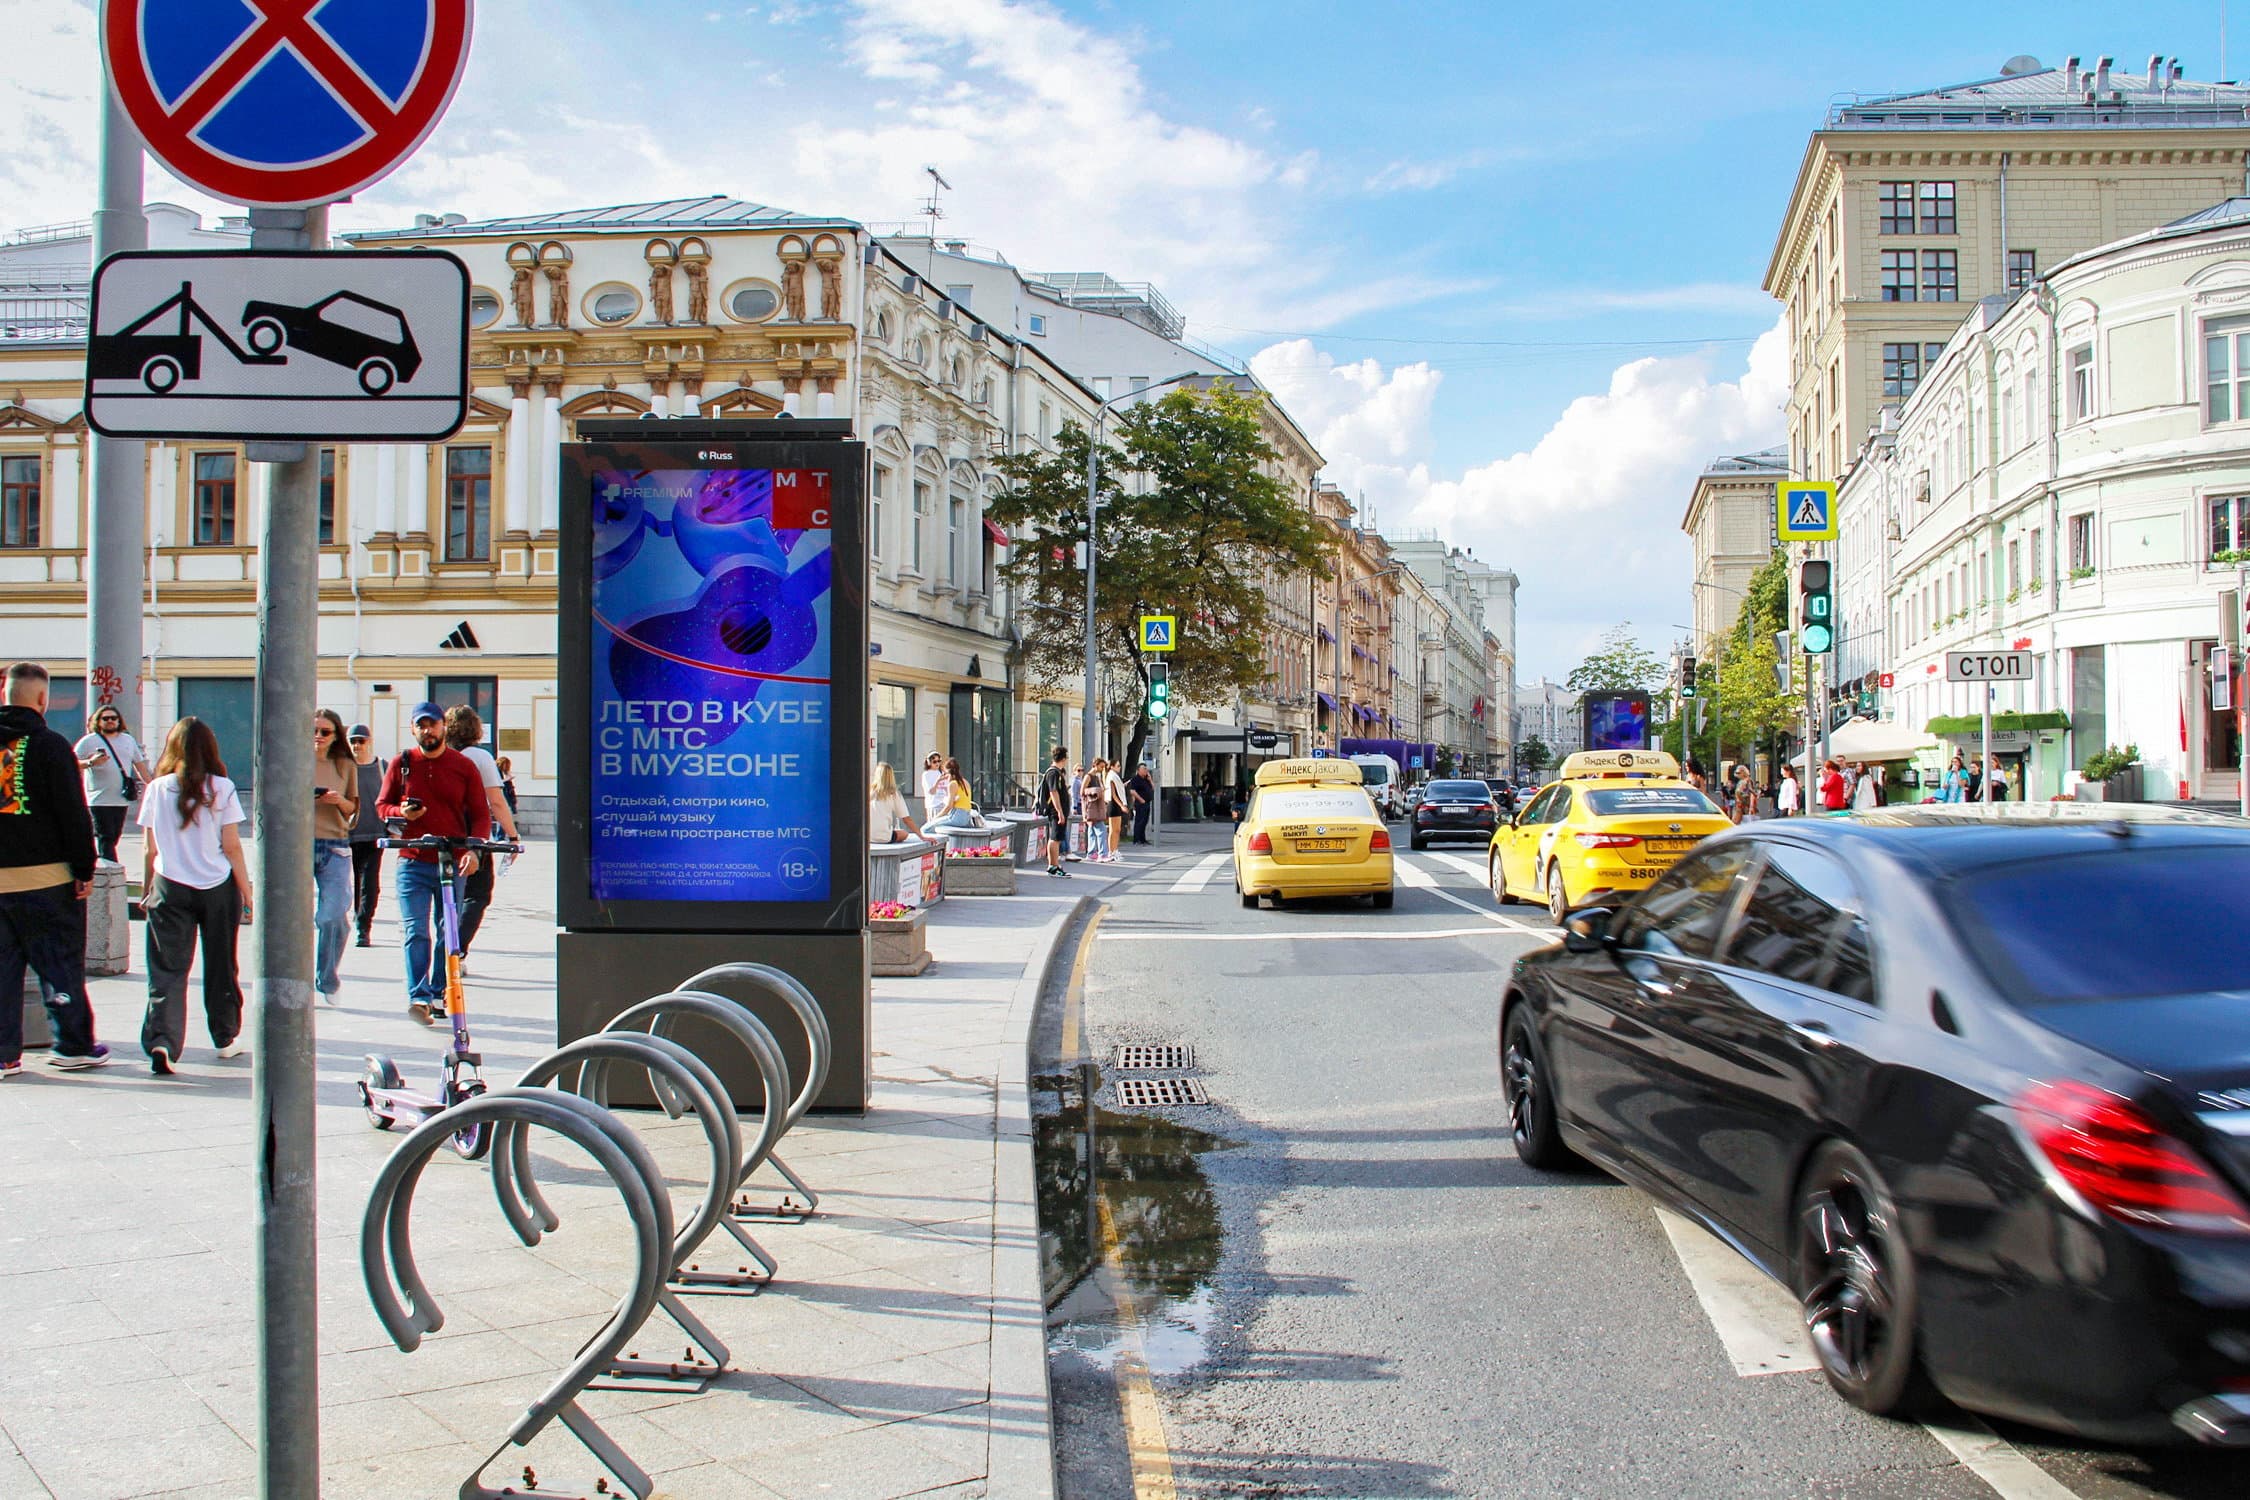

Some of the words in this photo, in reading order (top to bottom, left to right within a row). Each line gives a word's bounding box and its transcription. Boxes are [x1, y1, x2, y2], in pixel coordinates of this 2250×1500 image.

[709, 451, 733, 460] Russ
[623, 487, 693, 498] PREMIUM
[1960, 655, 2020, 676] СТОП
[600, 700, 694, 724] ЛЕТО
[702, 700, 724, 724] В
[732, 700, 823, 724] КУБЕ
[600, 727, 624, 750] С
[631, 727, 707, 750] МТС
[601, 753, 622, 776] В
[631, 753, 801, 776] МУЗЕОНЕ
[1584, 756, 1616, 766] Яндекс
[1619, 755, 1632, 766] Go
[1636, 756, 1660, 765] Такси
[1280, 763, 1312, 775] Яндекс
[601, 794, 670, 808] Отдыхай,
[672, 797, 727, 809] смотри
[730, 797, 769, 809] кино,
[601, 810, 657, 825] слушай
[660, 813, 716, 825] музыку
[601, 828, 610, 837] в
[613, 826, 668, 838] Летнем
[671, 828, 774, 841] пространстве
[777, 826, 812, 839] МТС
[781, 862, 818, 877] 18+
